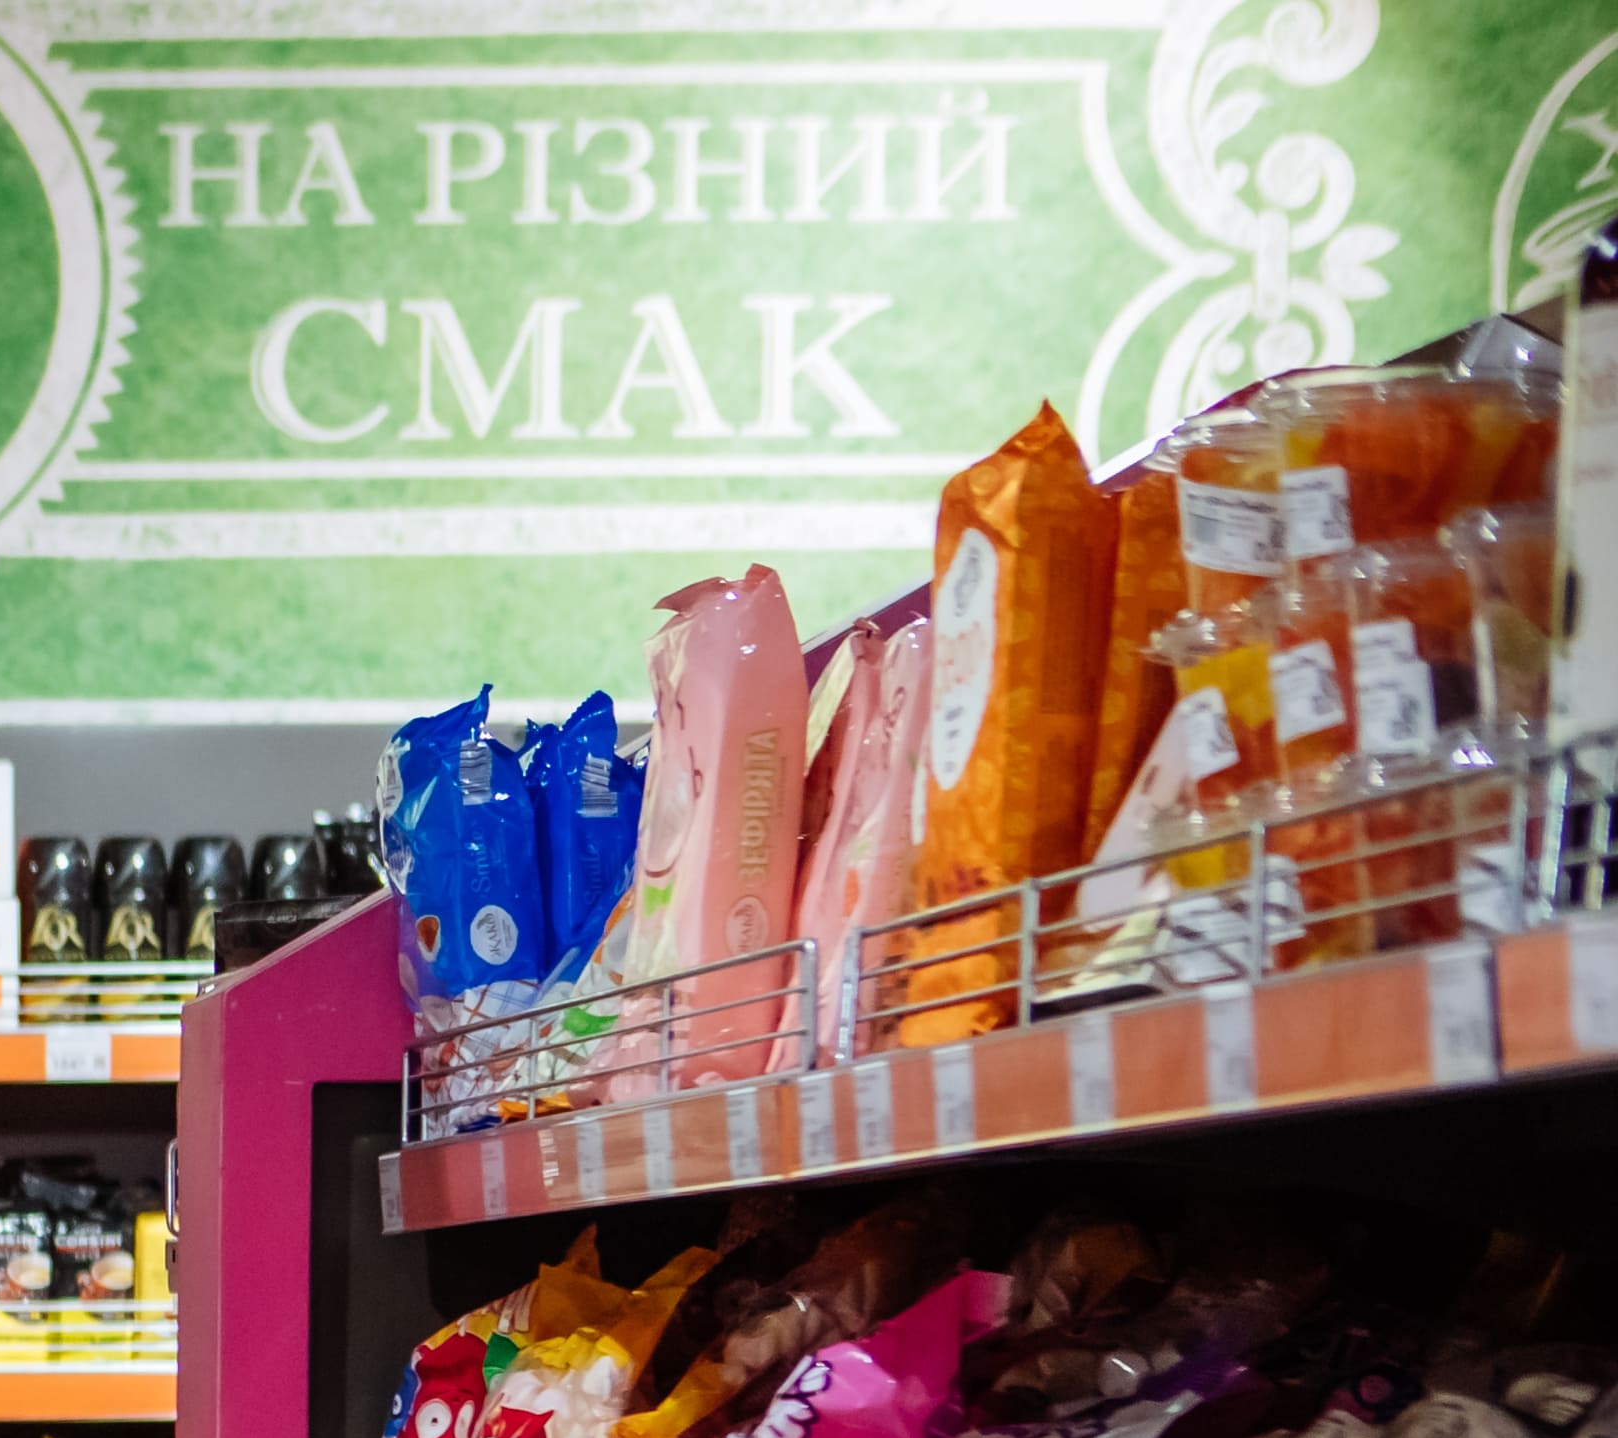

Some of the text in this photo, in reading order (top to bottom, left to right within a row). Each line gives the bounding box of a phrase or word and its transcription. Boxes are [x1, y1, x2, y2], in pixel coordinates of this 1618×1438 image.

[157, 86, 1020, 228] НА РІЗНИЙ
[250, 294, 902, 444] СМАК
